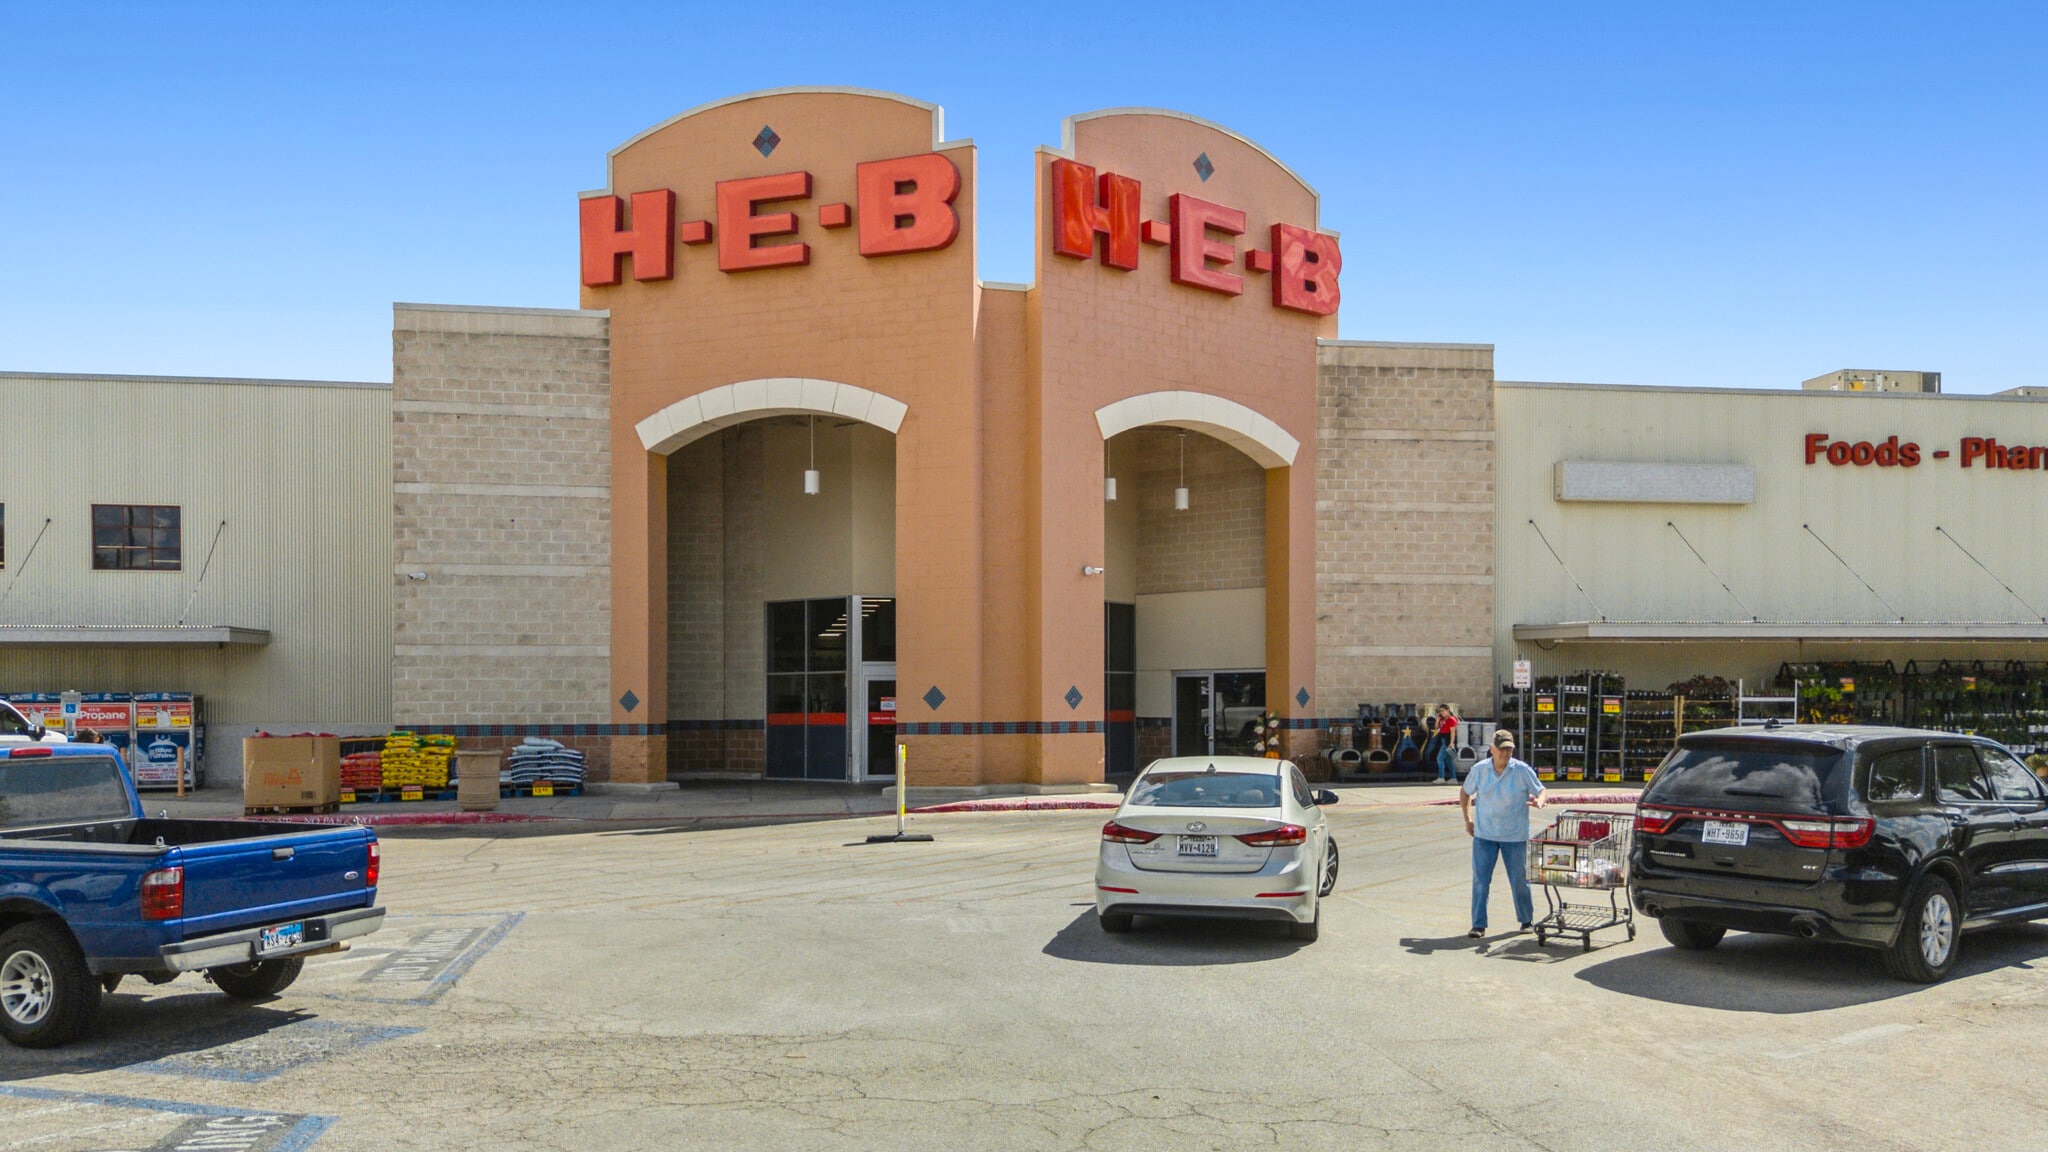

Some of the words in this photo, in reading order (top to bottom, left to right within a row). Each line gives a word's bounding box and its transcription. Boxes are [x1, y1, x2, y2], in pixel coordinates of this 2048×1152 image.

[579, 153, 961, 288] H-E-B
[1052, 157, 1343, 317] H-E-B
[1805, 433, 1921, 467] Foods
[1960, 436, 2048, 470] Phar
[80, 710, 126, 721] Propane
